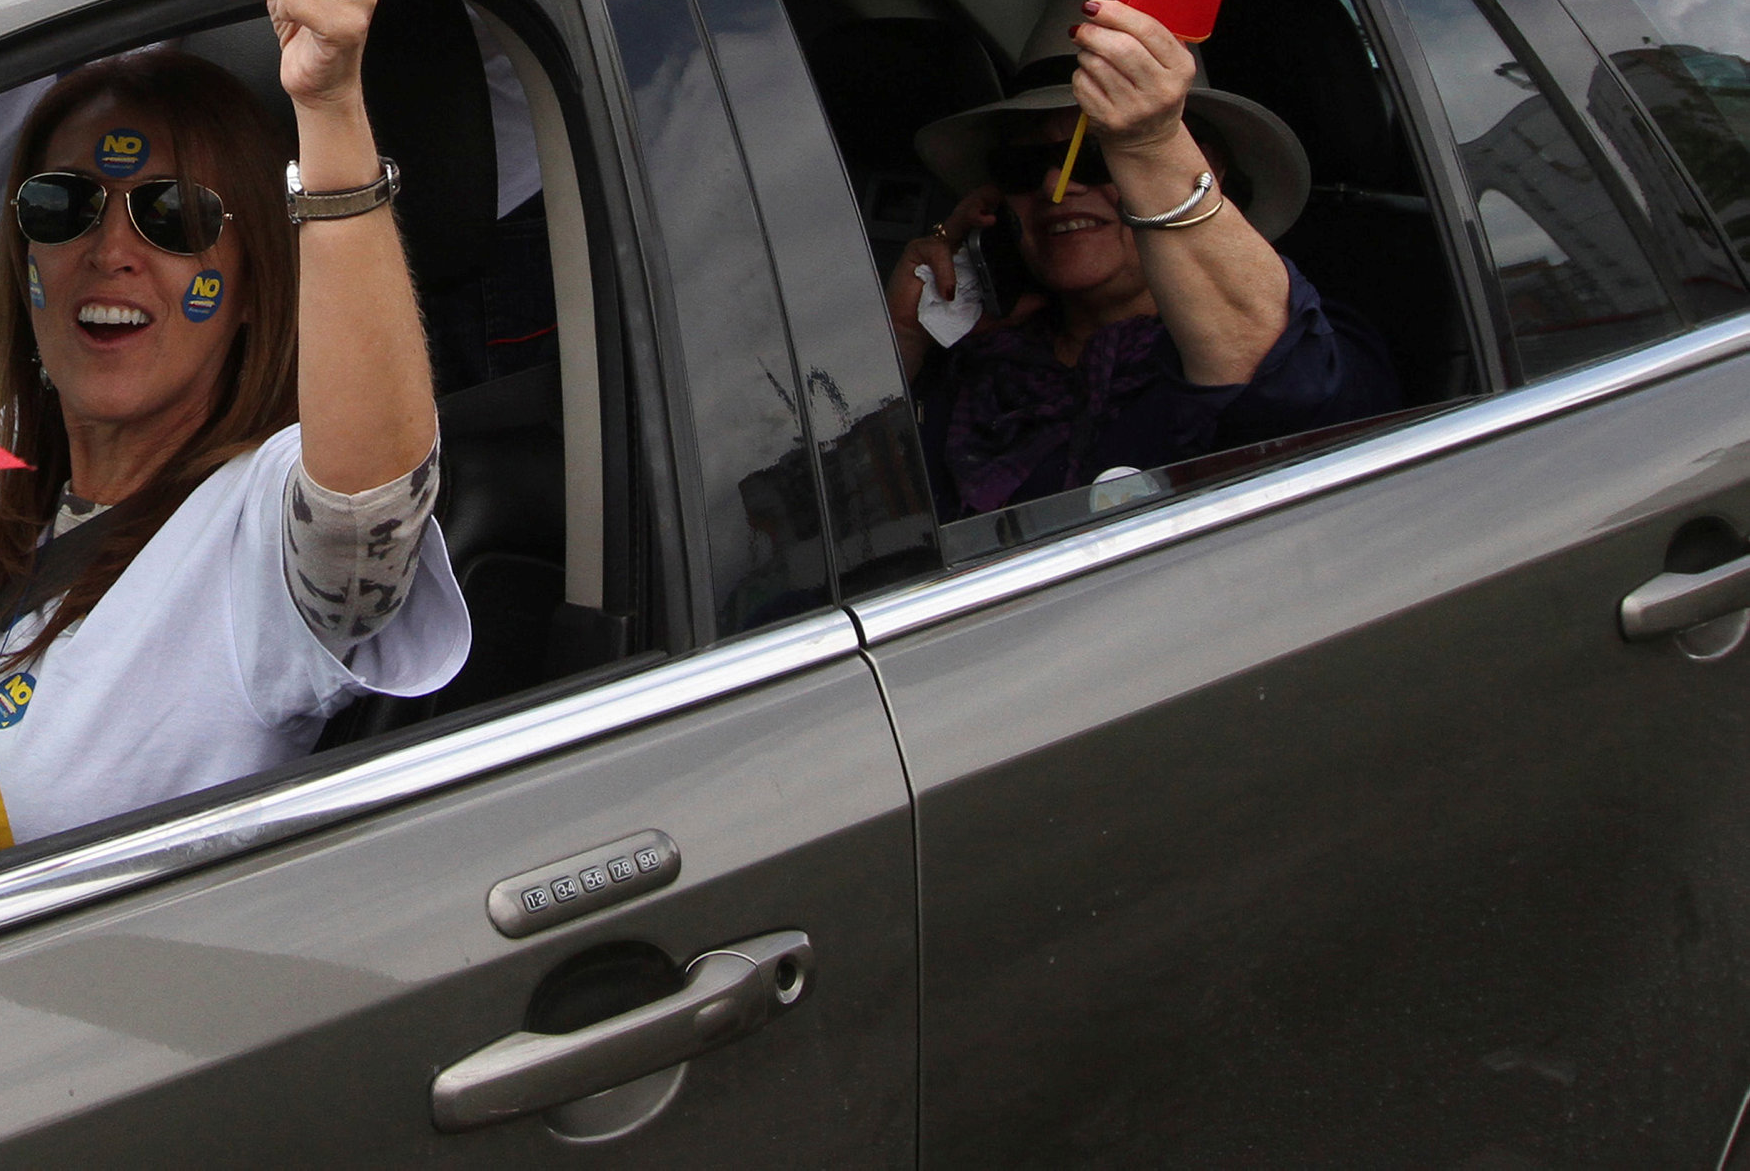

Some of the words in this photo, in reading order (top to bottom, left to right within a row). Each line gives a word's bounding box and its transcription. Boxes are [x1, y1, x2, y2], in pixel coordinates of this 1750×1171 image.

[103, 134, 143, 155] NO
[192, 276, 220, 298] NO
[4, 674, 33, 705] NO
